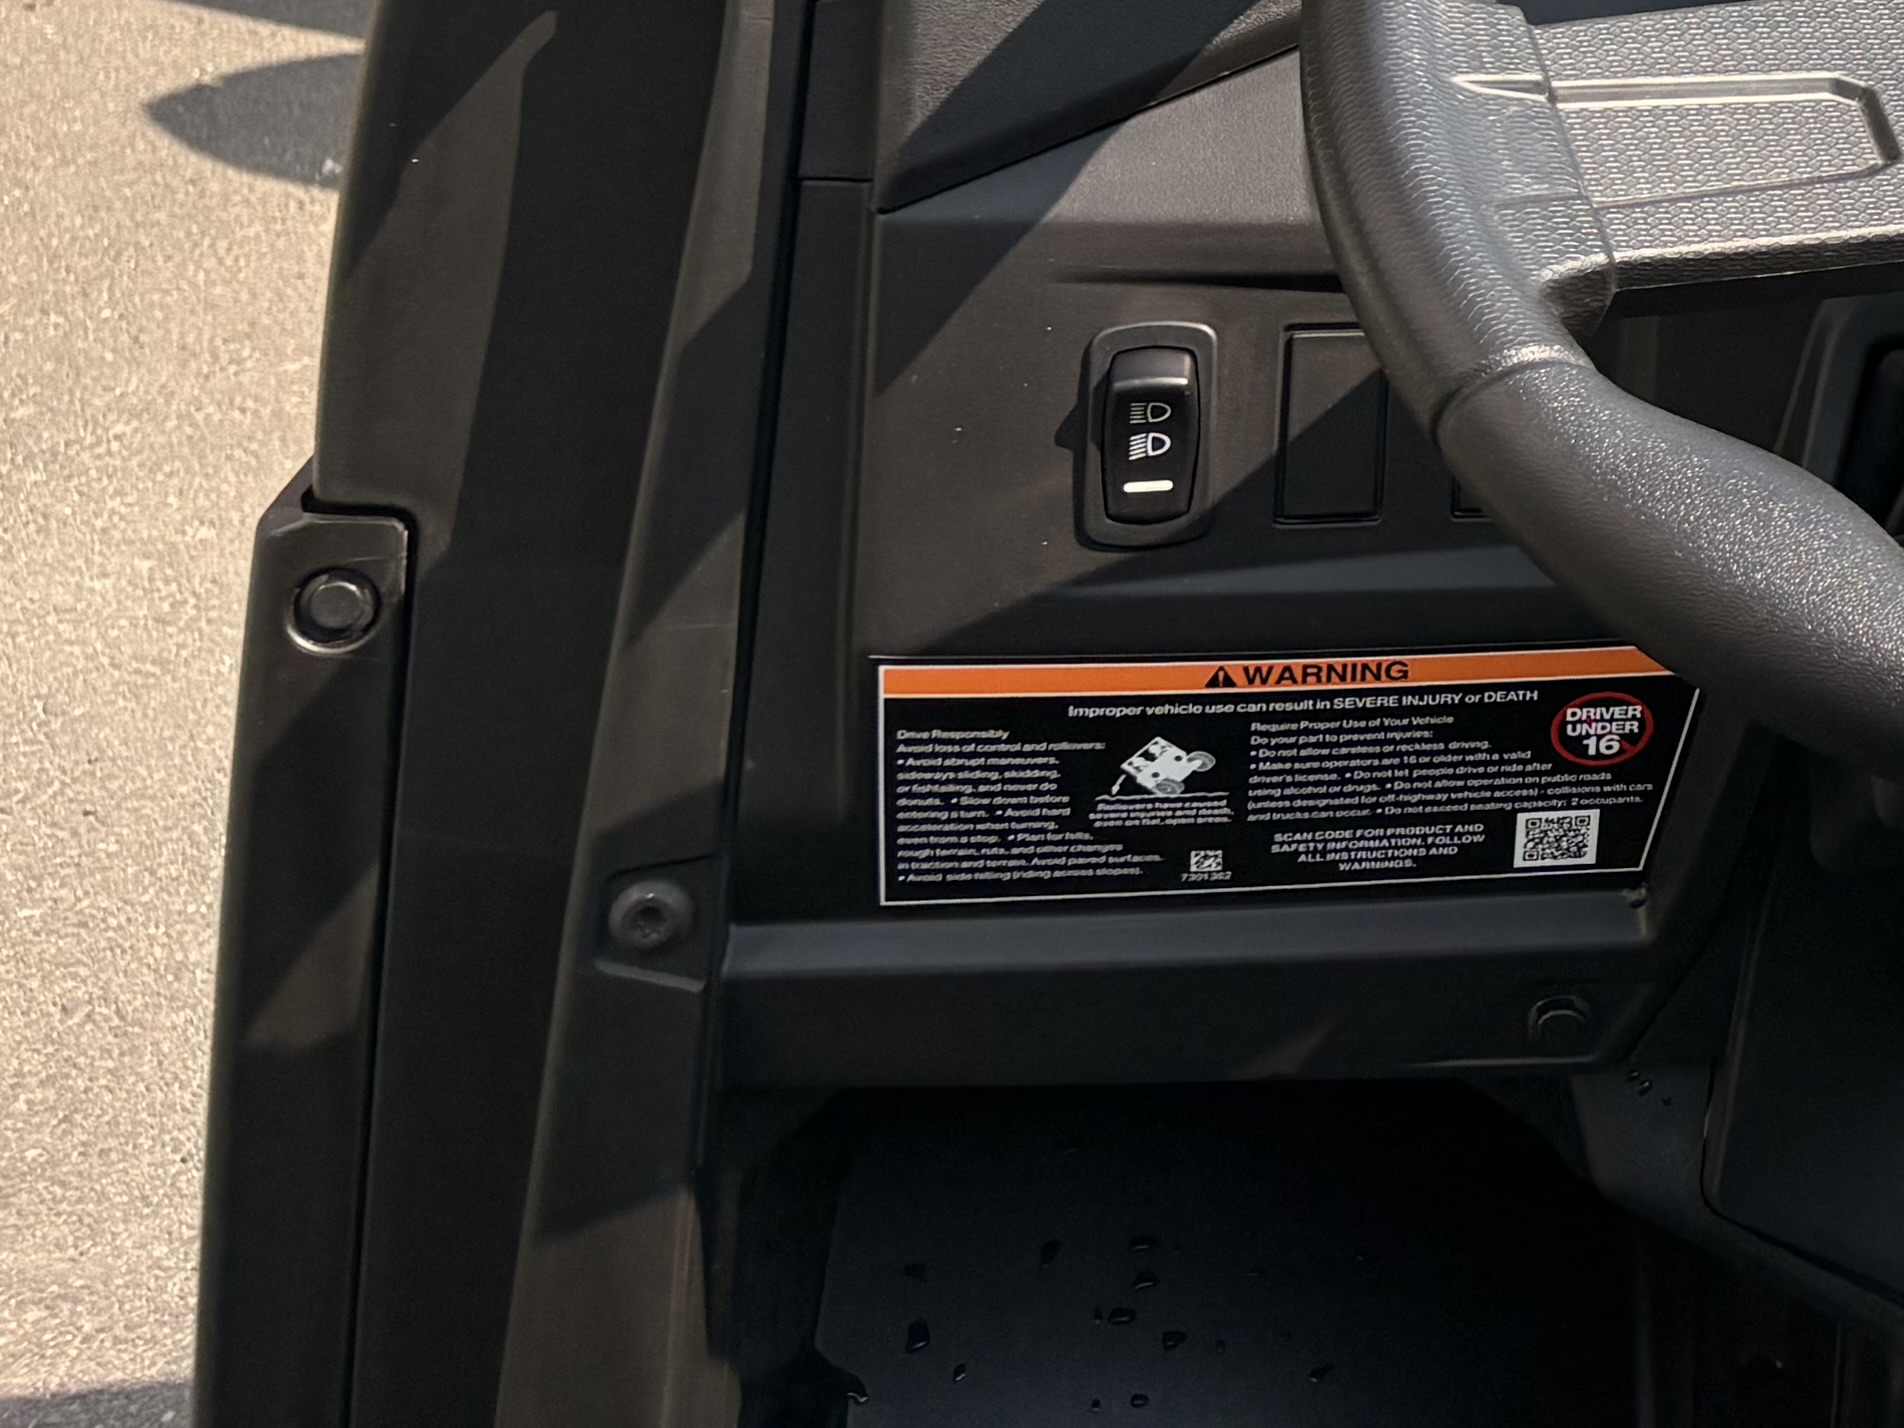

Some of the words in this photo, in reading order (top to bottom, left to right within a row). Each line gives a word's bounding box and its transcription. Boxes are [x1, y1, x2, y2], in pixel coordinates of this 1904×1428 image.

[1243, 661, 1409, 686] WARNING
[1068, 706, 1143, 717] Improper
[1144, 704, 1202, 714] vehicle
[1205, 705, 1234, 713] use
[1236, 704, 1266, 712] can
[1268, 700, 1314, 711] result
[1316, 700, 1330, 708] in
[1333, 696, 1398, 708] SEVERE
[1402, 693, 1462, 705] INJURY
[1465, 695, 1481, 703] or
[1484, 691, 1538, 702] DEATH
[1566, 705, 1643, 722] DRIVER
[1566, 721, 1640, 737] UNDER
[1583, 735, 1621, 756] 16
